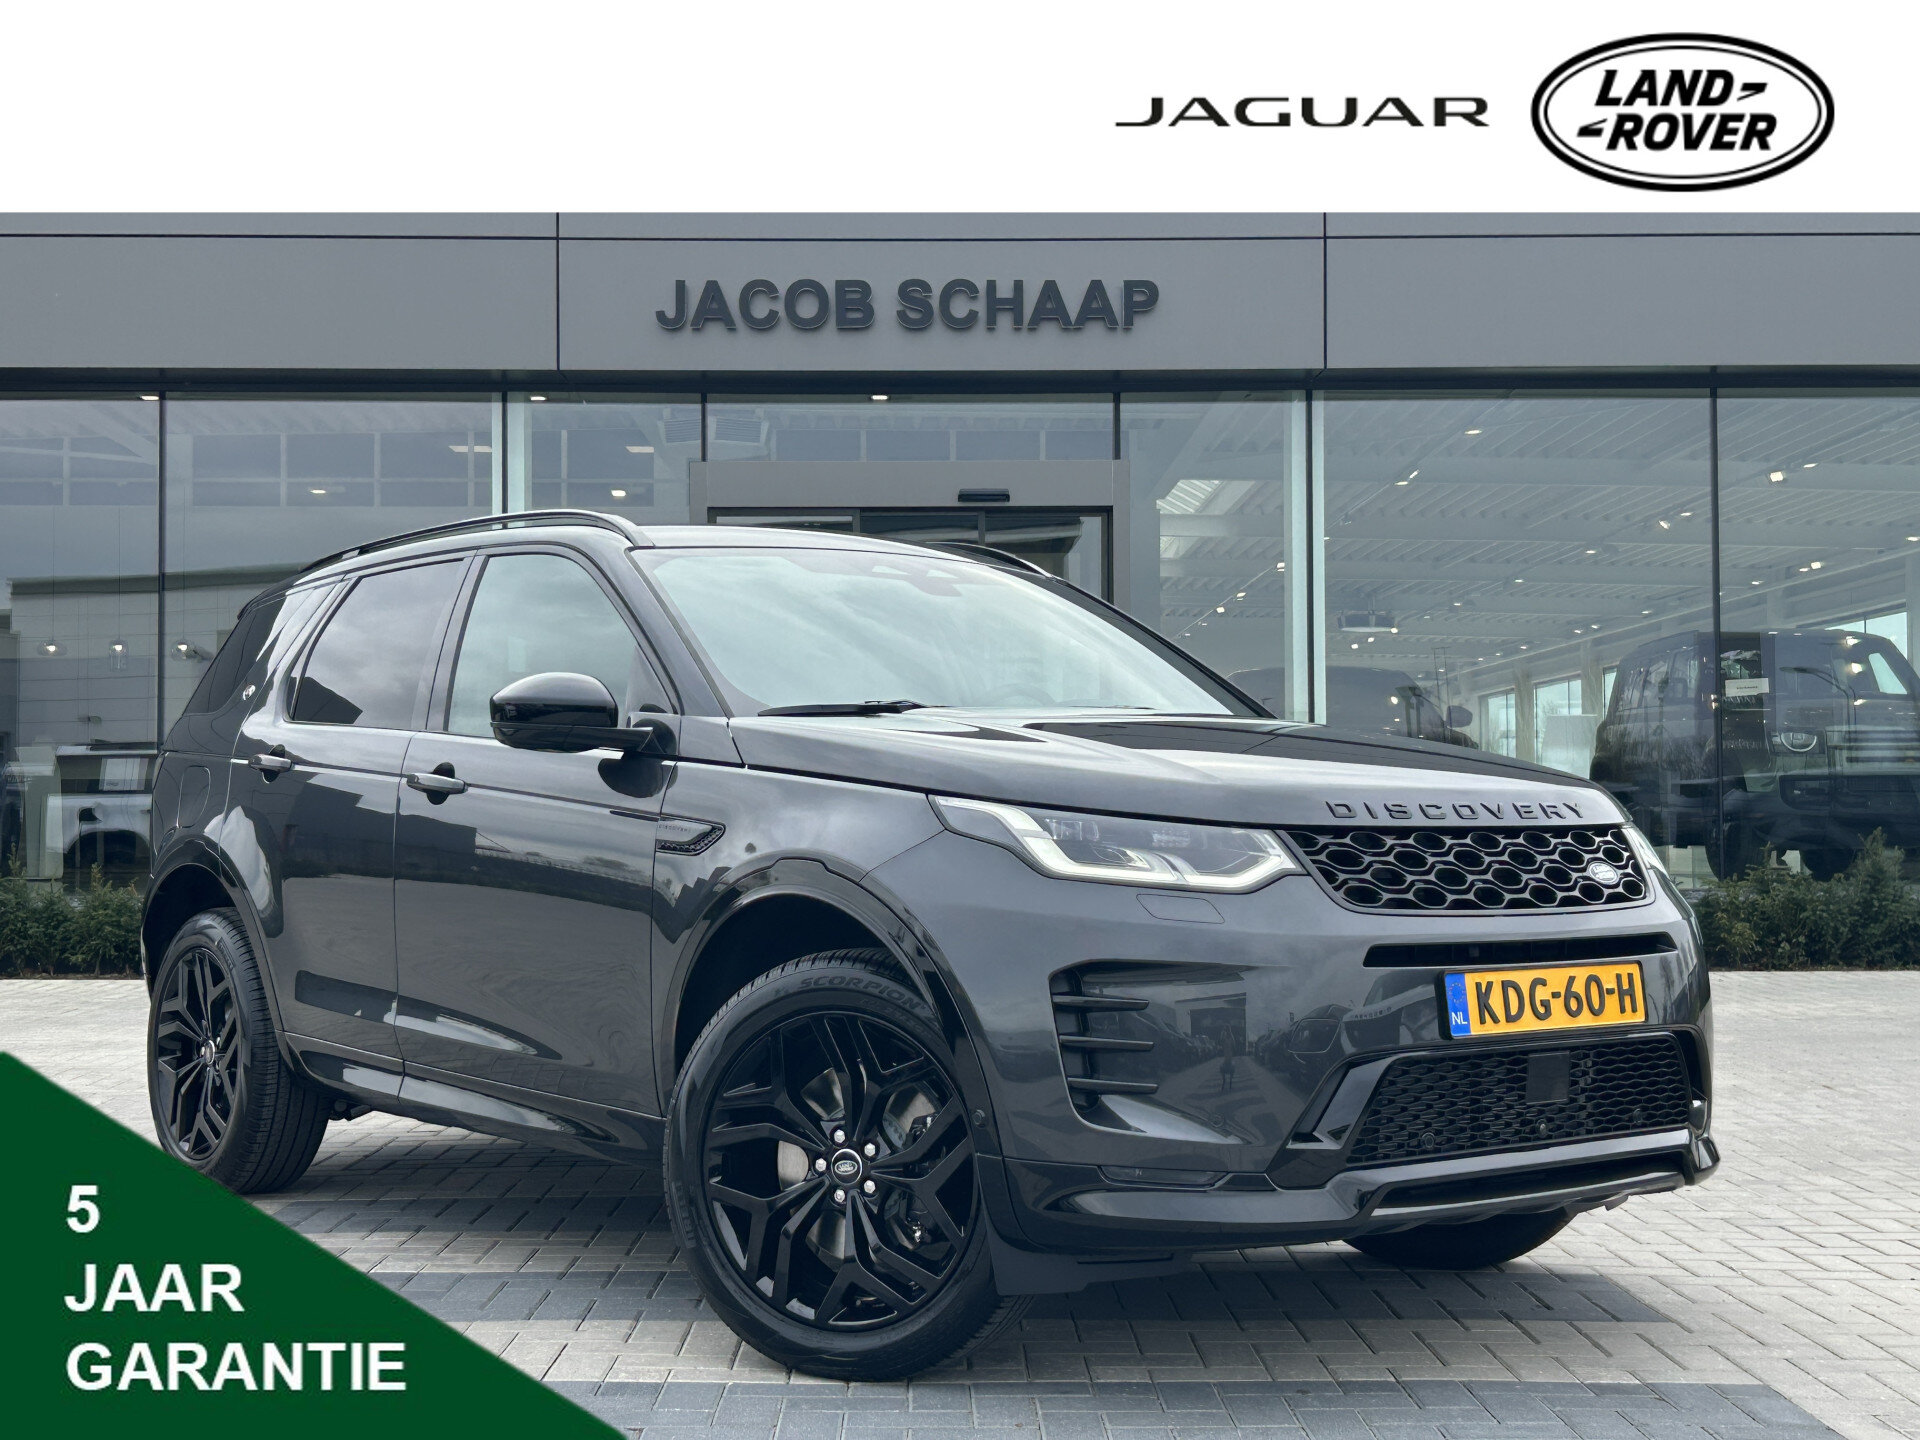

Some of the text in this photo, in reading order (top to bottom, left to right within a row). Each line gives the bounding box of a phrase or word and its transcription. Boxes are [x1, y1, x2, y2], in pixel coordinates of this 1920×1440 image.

[655, 278, 1160, 330] JACOB SCHAAP
[1325, 800, 1584, 820] DISCOVERY
[799, 975, 922, 1010] SCORPION
[1475, 972, 1638, 1025] KDG-60-H
[1451, 1011, 1468, 1025] NL
